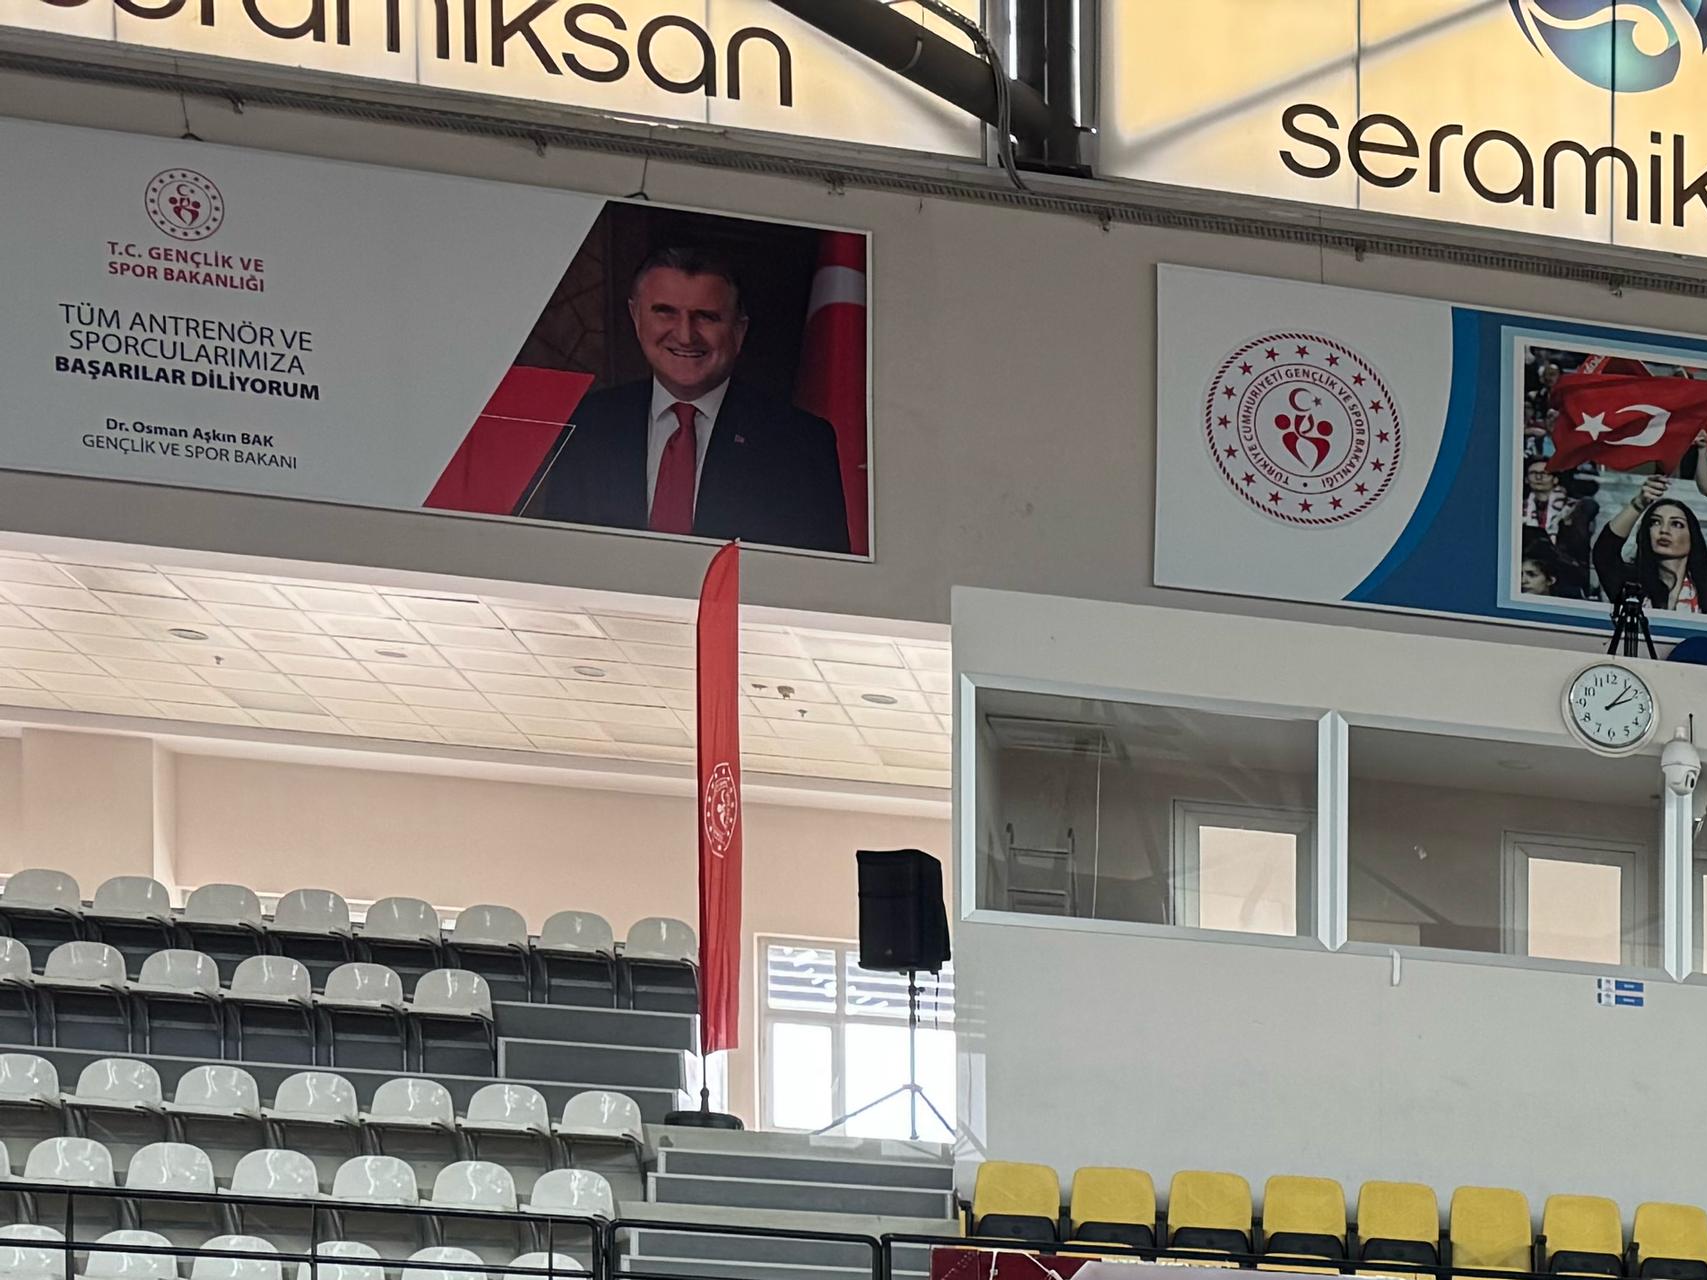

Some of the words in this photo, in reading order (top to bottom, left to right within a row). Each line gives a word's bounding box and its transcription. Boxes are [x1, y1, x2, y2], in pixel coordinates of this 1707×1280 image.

[50, 0, 793, 107] amiksan
[108, 241, 142, 258] T.C.
[148, 246, 232, 269] GENÇLİK
[240, 258, 263, 272] VE
[108, 262, 157, 279] SPOR
[164, 268, 264, 292] BAKANLIĞI
[59, 302, 120, 329] TÜM
[130, 312, 274, 347] ANTRENÖR
[281, 329, 312, 351] VE
[70, 330, 304, 375] SPORCULARIMIZA
[56, 356, 185, 385] BAŞARILAR
[192, 370, 319, 400] DİLİYORUM
[1285, 369, 1337, 391] GENÇLİK
[1338, 387, 1352, 402] VE
[1242, 370, 1284, 442] CUMHURİYETİ
[1349, 403, 1365, 435] SPOR
[106, 418, 129, 431] Dr.
[133, 422, 188, 439] Osman
[193, 428, 236, 444] Aşkın
[241, 433, 273, 448] BAK
[82, 434, 156, 454] GENÇLİK
[159, 442, 180, 456] VE
[185, 446, 229, 461] SPOR
[235, 451, 297, 469] BAKANI
[1248, 444, 1290, 486] TÜRKİYE
[1321, 439, 1365, 488] BAKANLIĞI
[1584, 687, 1595, 696] 10
